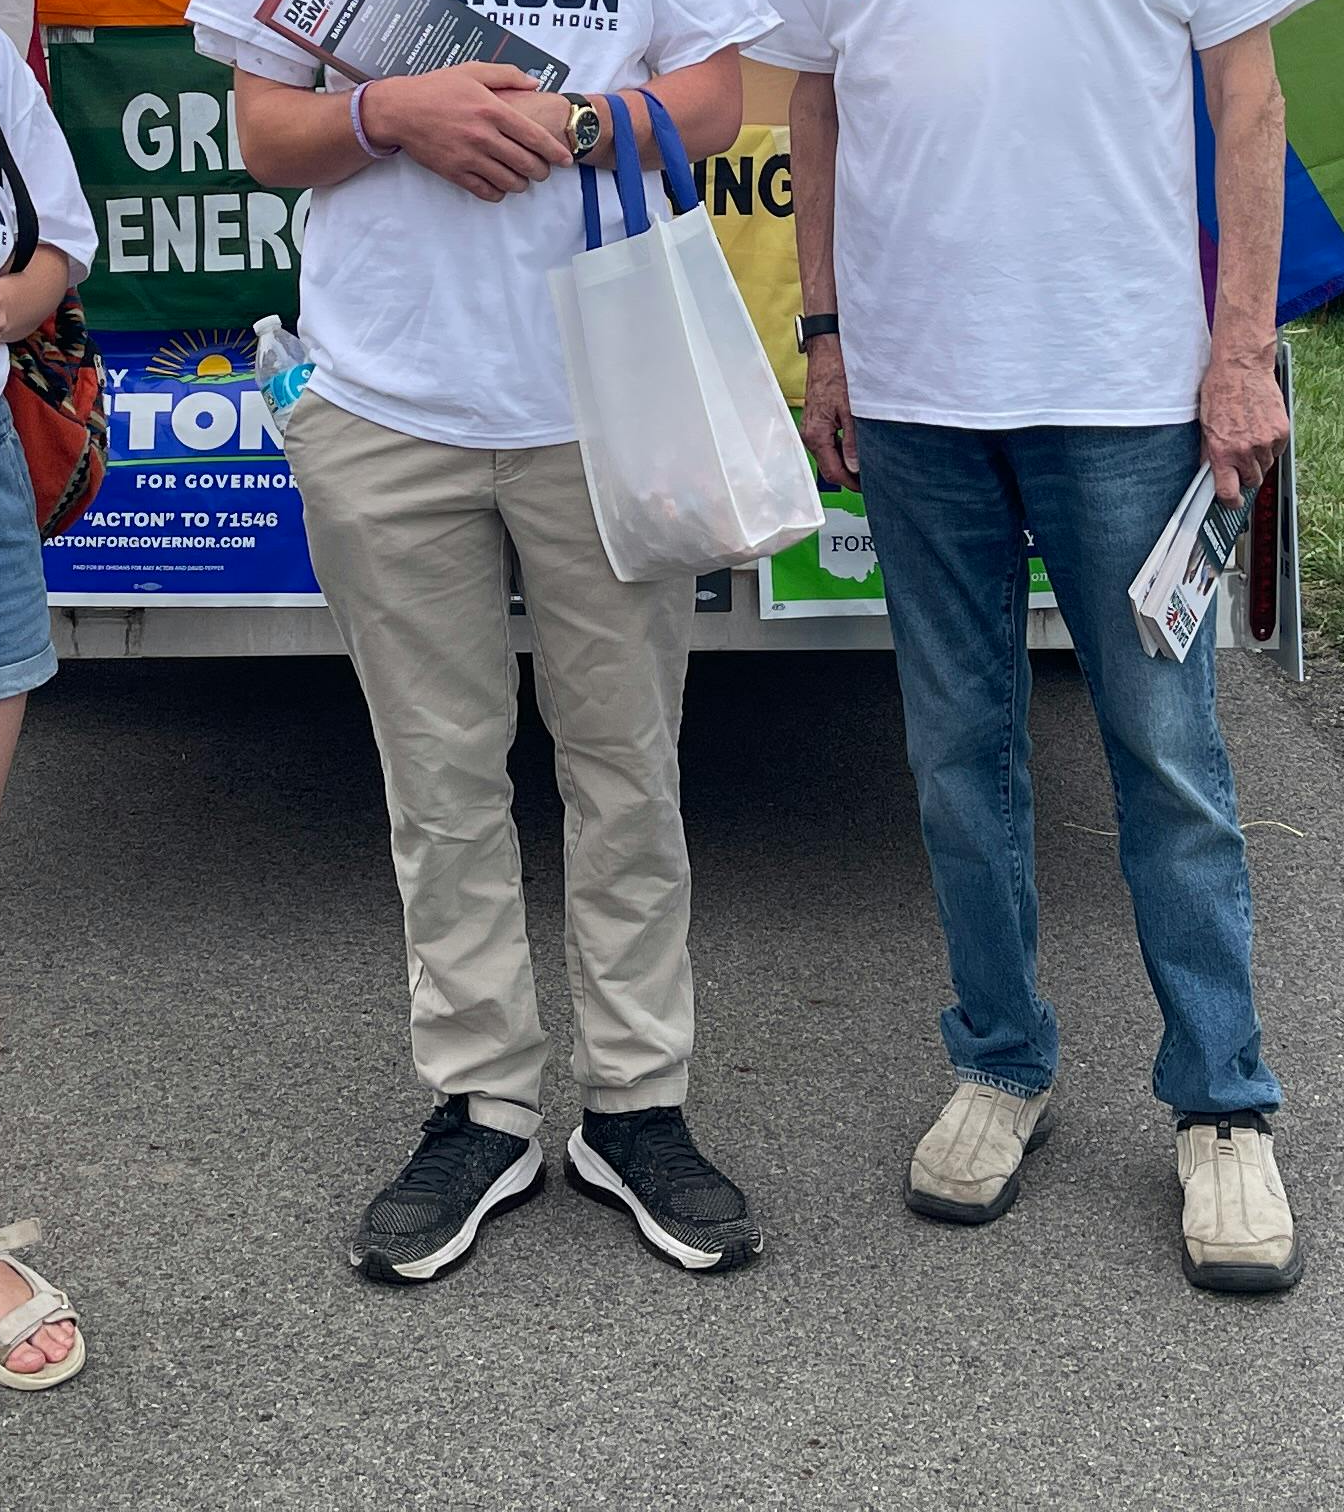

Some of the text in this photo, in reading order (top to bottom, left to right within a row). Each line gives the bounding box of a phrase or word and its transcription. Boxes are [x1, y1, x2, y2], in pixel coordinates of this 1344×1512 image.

[330, 11, 352, 40] DAVE'S
[552, 14, 618, 31] HOUSE
[405, 23, 434, 66] HEALTHCARE
[102, 392, 284, 450] TON
[136, 474, 176, 489] FOR
[181, 512, 210, 527] TO
[216, 512, 279, 527] 71546
